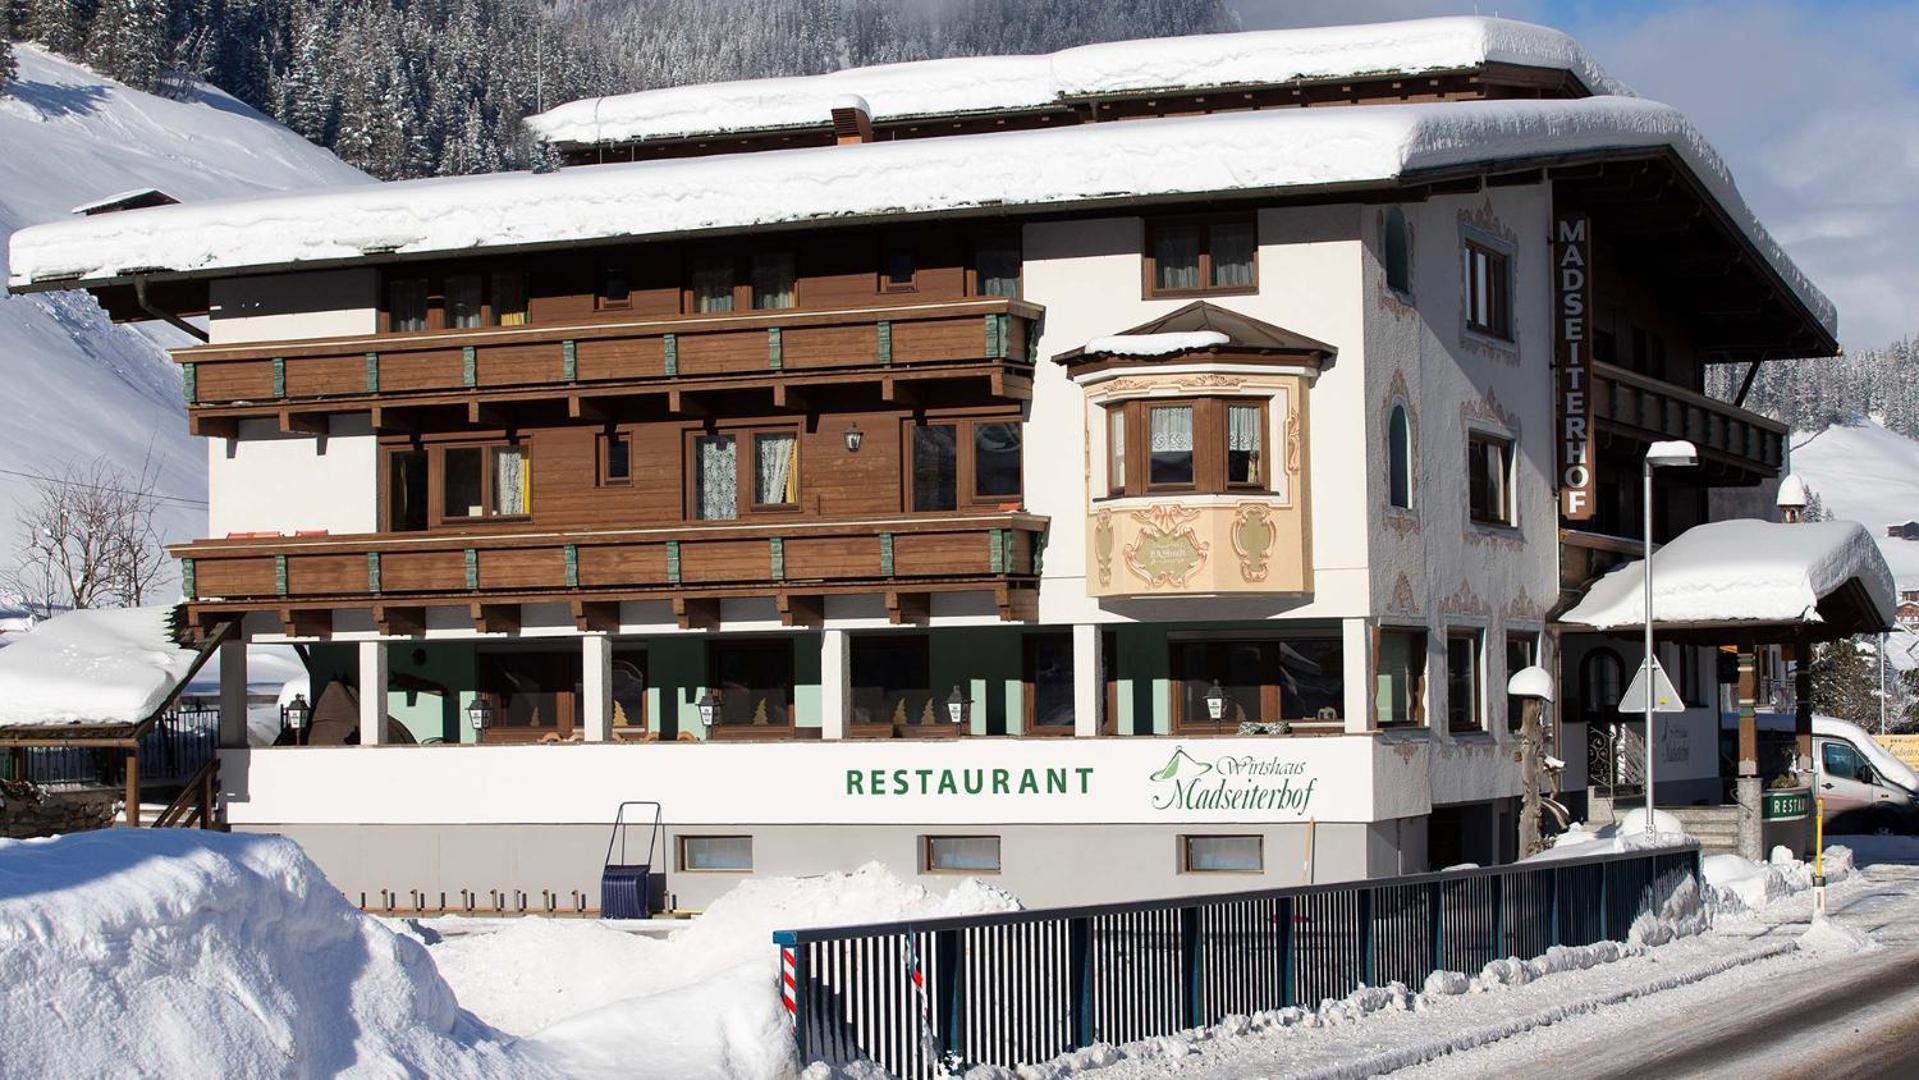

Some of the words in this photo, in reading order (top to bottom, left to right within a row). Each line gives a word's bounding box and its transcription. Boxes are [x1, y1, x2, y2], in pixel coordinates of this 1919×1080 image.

[1559, 219, 1590, 514] MADSEITERHOF
[846, 768, 1094, 795] RESTAURANT
[1216, 755, 1307, 776] Wirtshaus
[1151, 778, 1318, 816] Madseiterhof
